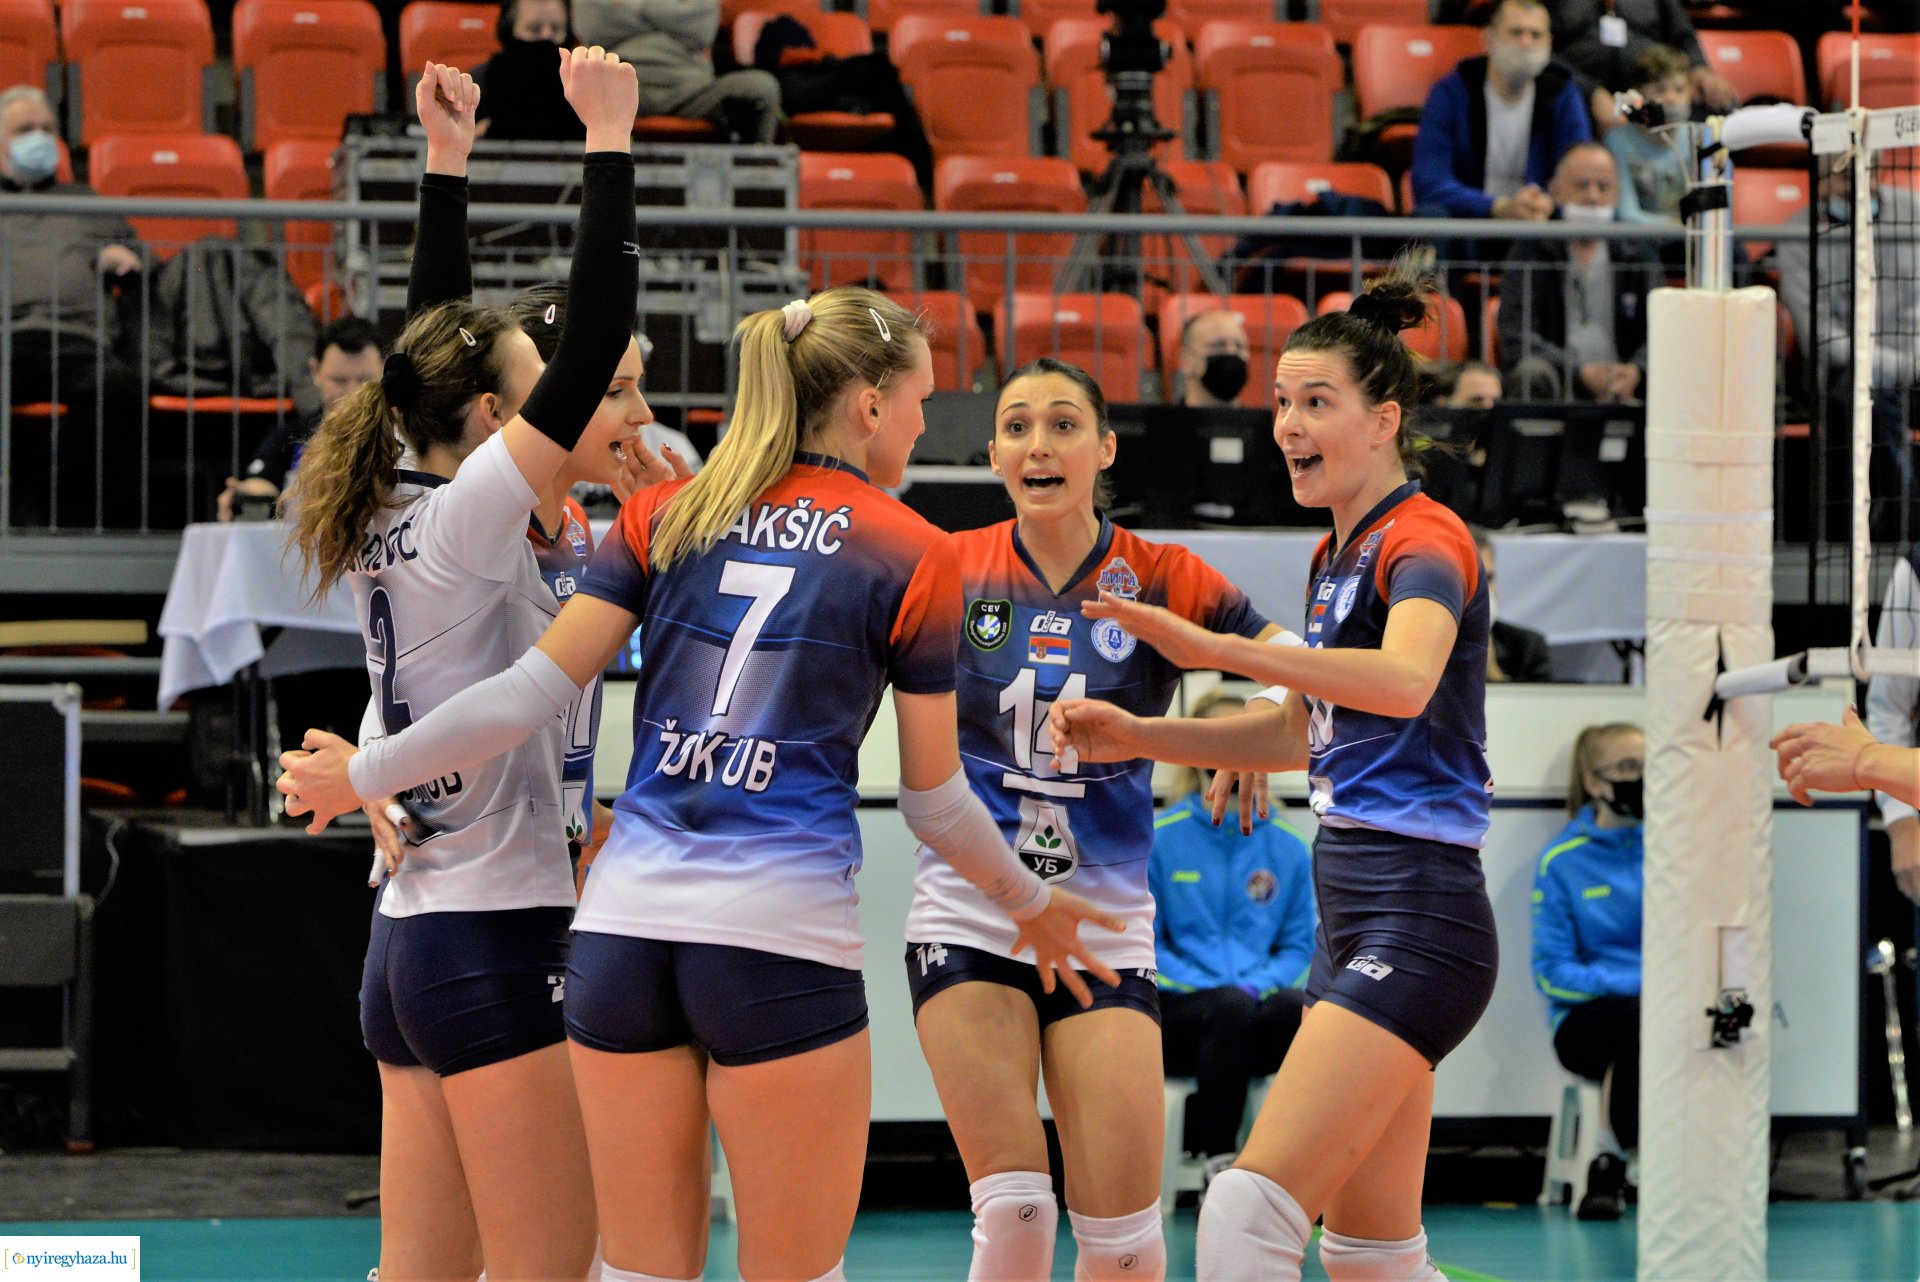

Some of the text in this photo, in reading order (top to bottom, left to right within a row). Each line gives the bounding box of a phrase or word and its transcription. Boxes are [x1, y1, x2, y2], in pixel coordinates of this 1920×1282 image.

[708, 499, 850, 555] AKŠIĆ
[711, 560, 796, 717] 7
[981, 604, 1000, 613] CEV
[369, 587, 414, 737] 2
[655, 719, 726, 783] ŽOK
[722, 738, 777, 792] UB
[999, 667, 1087, 775] 14
[1034, 856, 1058, 873] УБ
